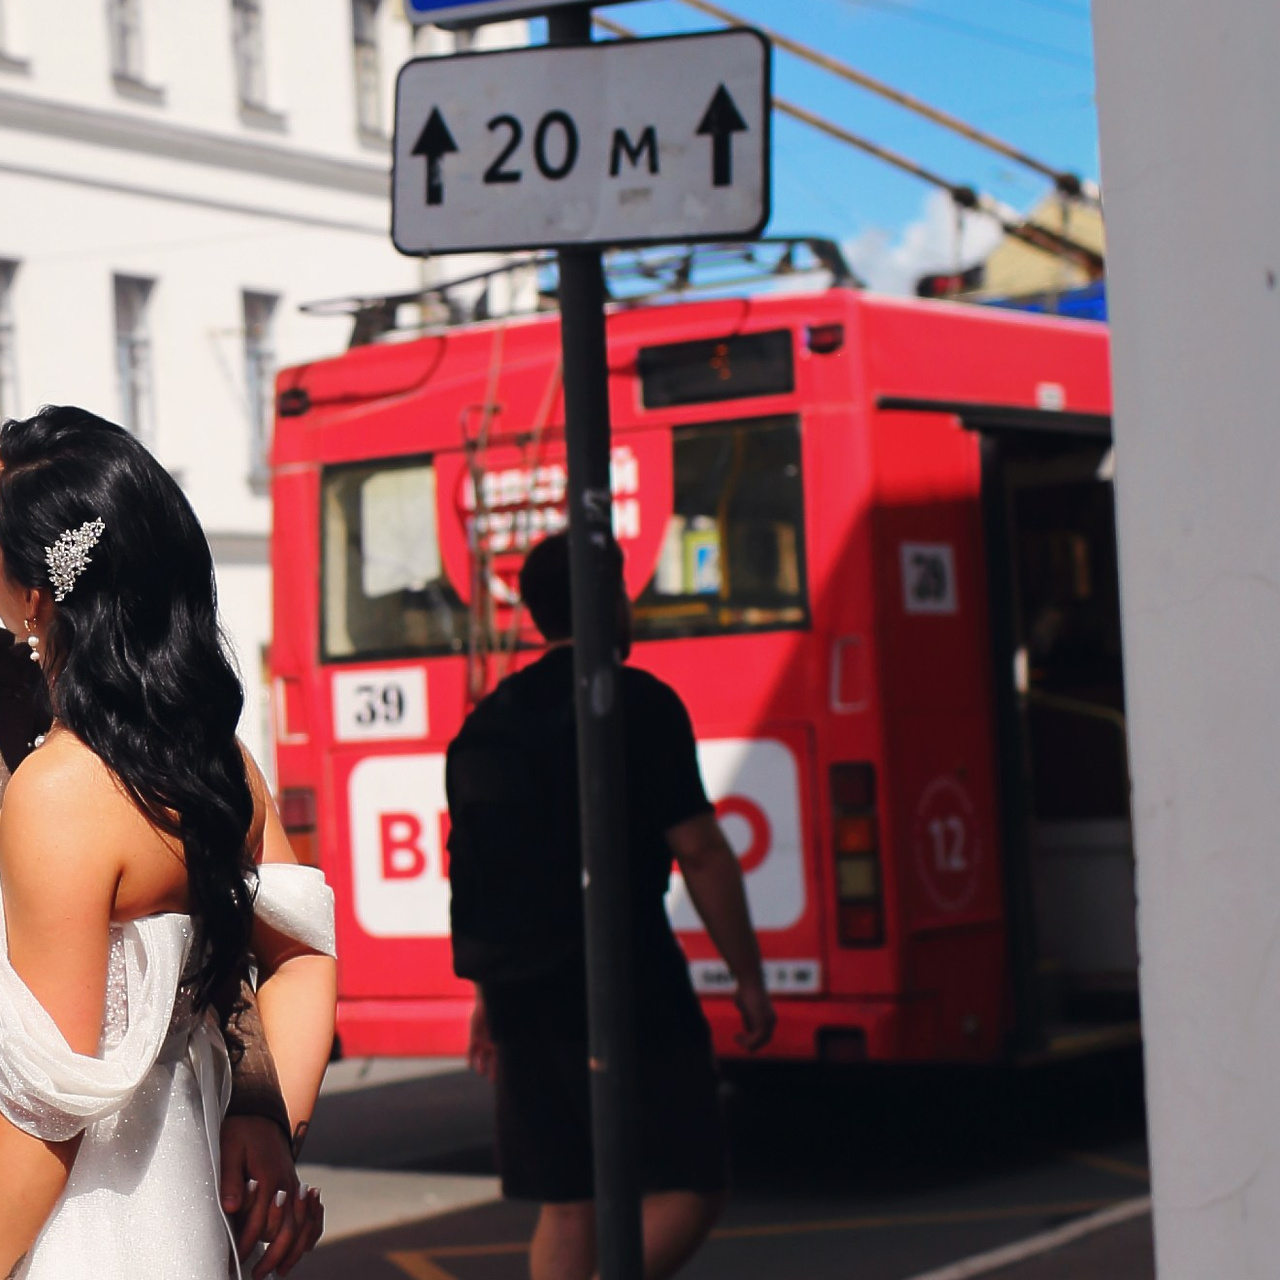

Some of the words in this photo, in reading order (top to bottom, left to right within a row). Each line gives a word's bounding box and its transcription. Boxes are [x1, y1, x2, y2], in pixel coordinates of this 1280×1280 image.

[482, 109, 580, 184] 20
[354, 682, 406, 726] 39
[928, 815, 968, 873] 12
